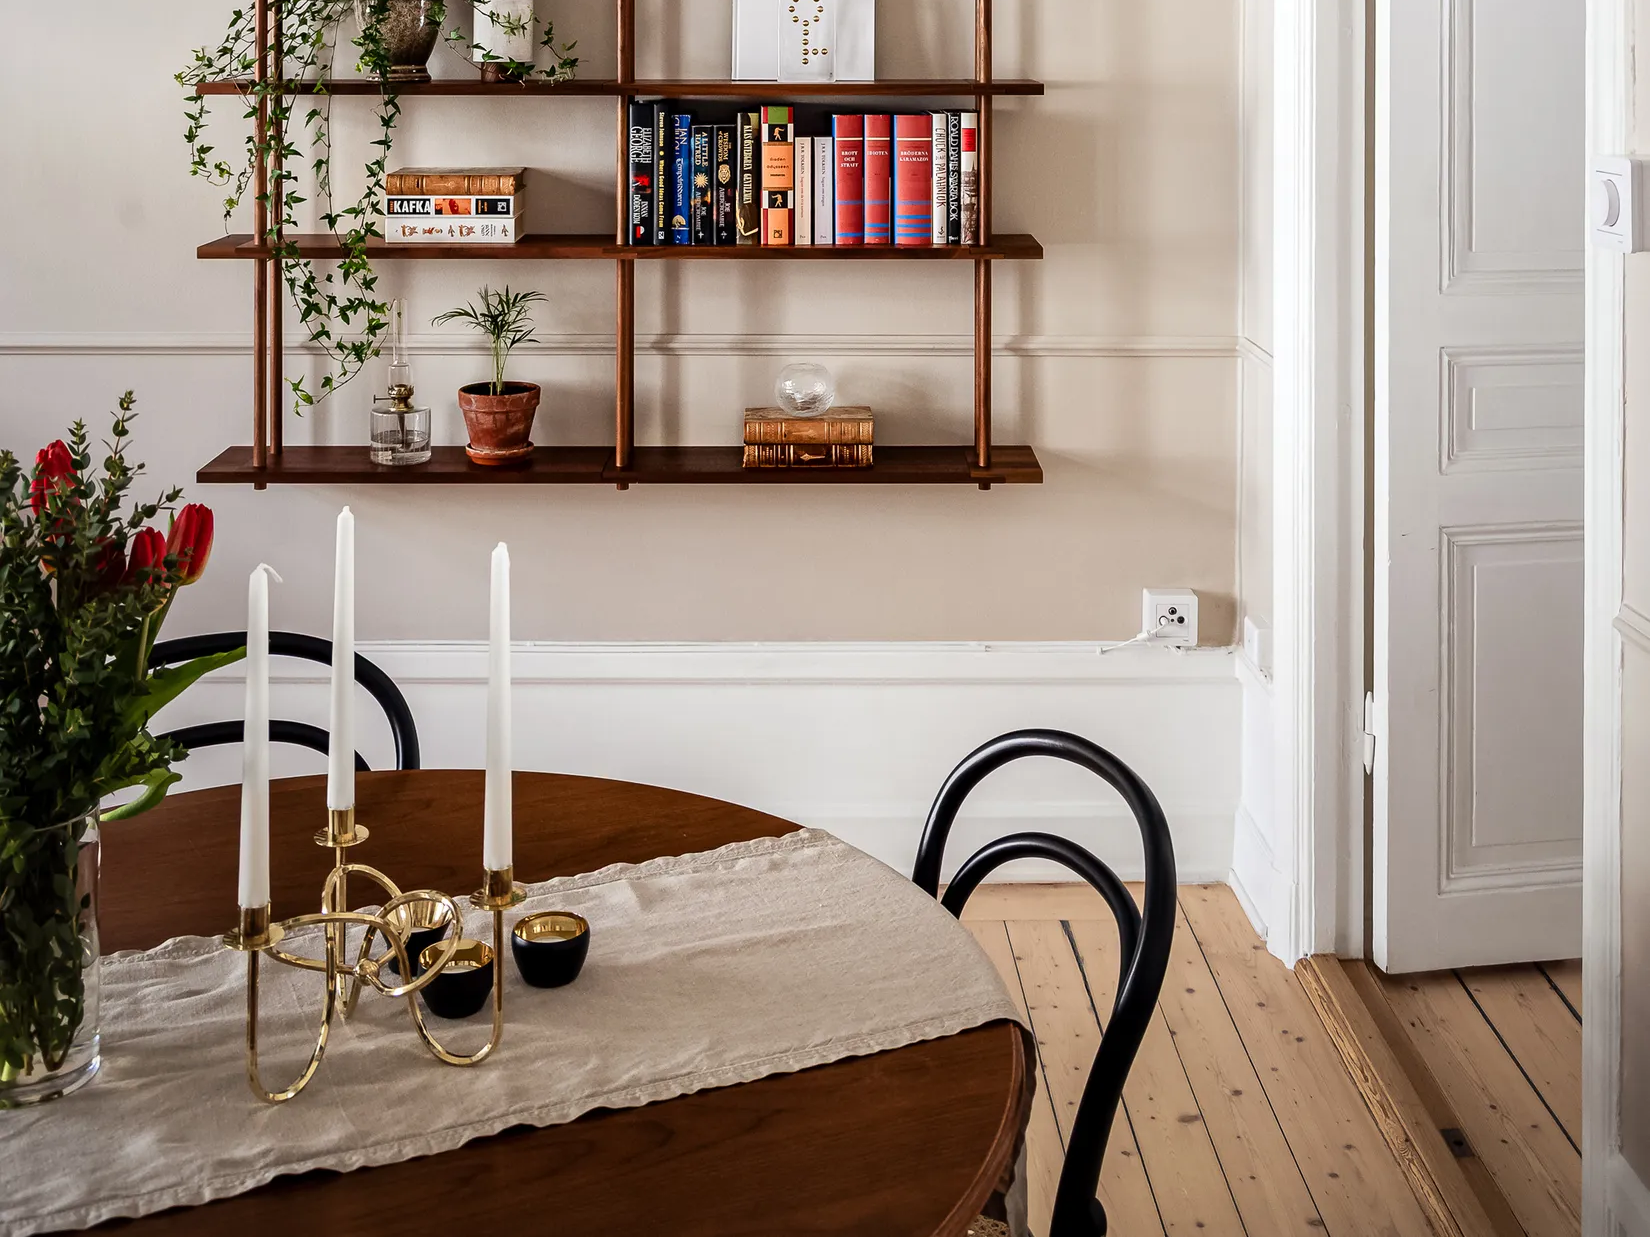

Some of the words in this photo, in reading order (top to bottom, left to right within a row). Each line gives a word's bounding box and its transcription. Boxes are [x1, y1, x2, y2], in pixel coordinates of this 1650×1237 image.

[680, 128, 688, 144] JAN
[743, 125, 752, 139] KLAS
[935, 127, 946, 153] CHUCK
[950, 116, 959, 146] ROALD
[630, 125, 643, 164] GEORGE
[641, 127, 653, 164] ELIZABETH
[743, 139, 754, 170] ÖSTERGREN
[950, 147, 959, 171] DAHLS
[743, 173, 752, 204] GENTLEMEN
[935, 163, 946, 209] PALAHNIUK
[950, 172, 959, 201] SVARTA
[394, 200, 431, 213] KAFKA
[633, 194, 641, 212] DÖDEN
[641, 200, 649, 218] INNAN
[950, 202, 959, 222] BOK
[633, 213, 641, 224] KOM
